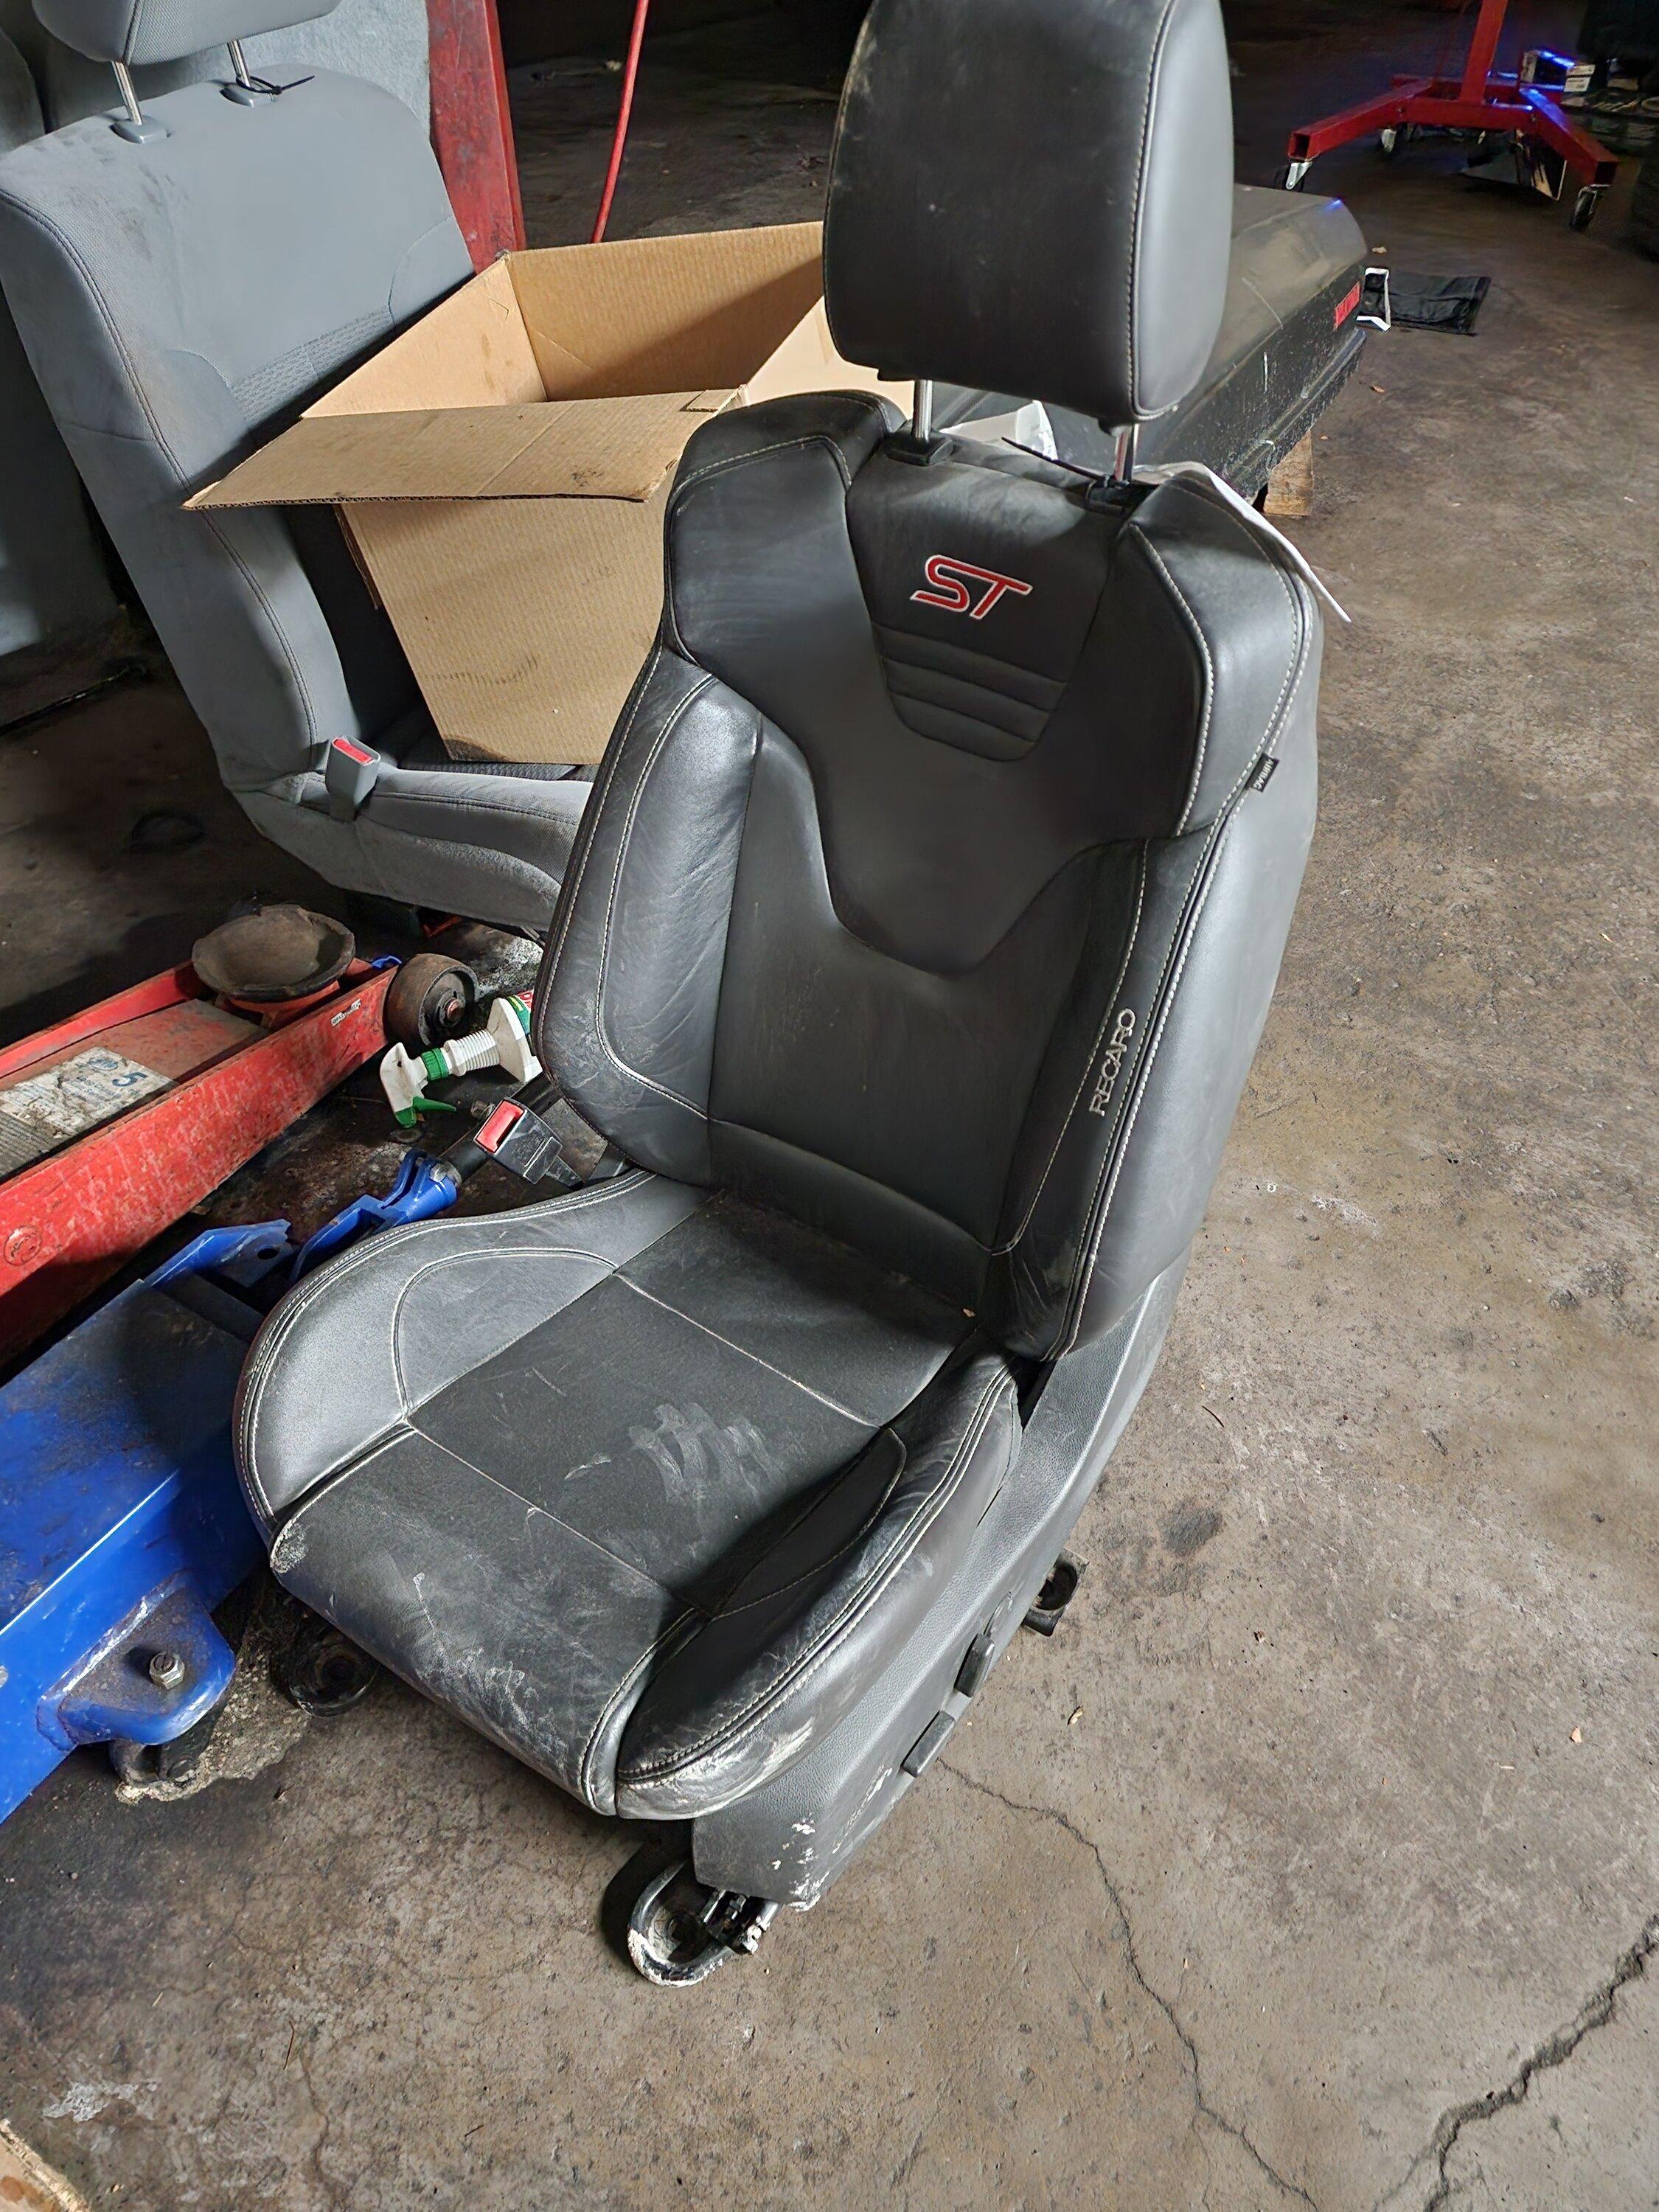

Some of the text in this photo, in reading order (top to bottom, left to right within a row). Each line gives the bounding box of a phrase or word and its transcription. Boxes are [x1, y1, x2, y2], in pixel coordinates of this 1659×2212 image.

[909, 554, 1034, 619] ST
[112, 1071, 147, 1087] 5
[1088, 1007, 1136, 1117] RECARO
